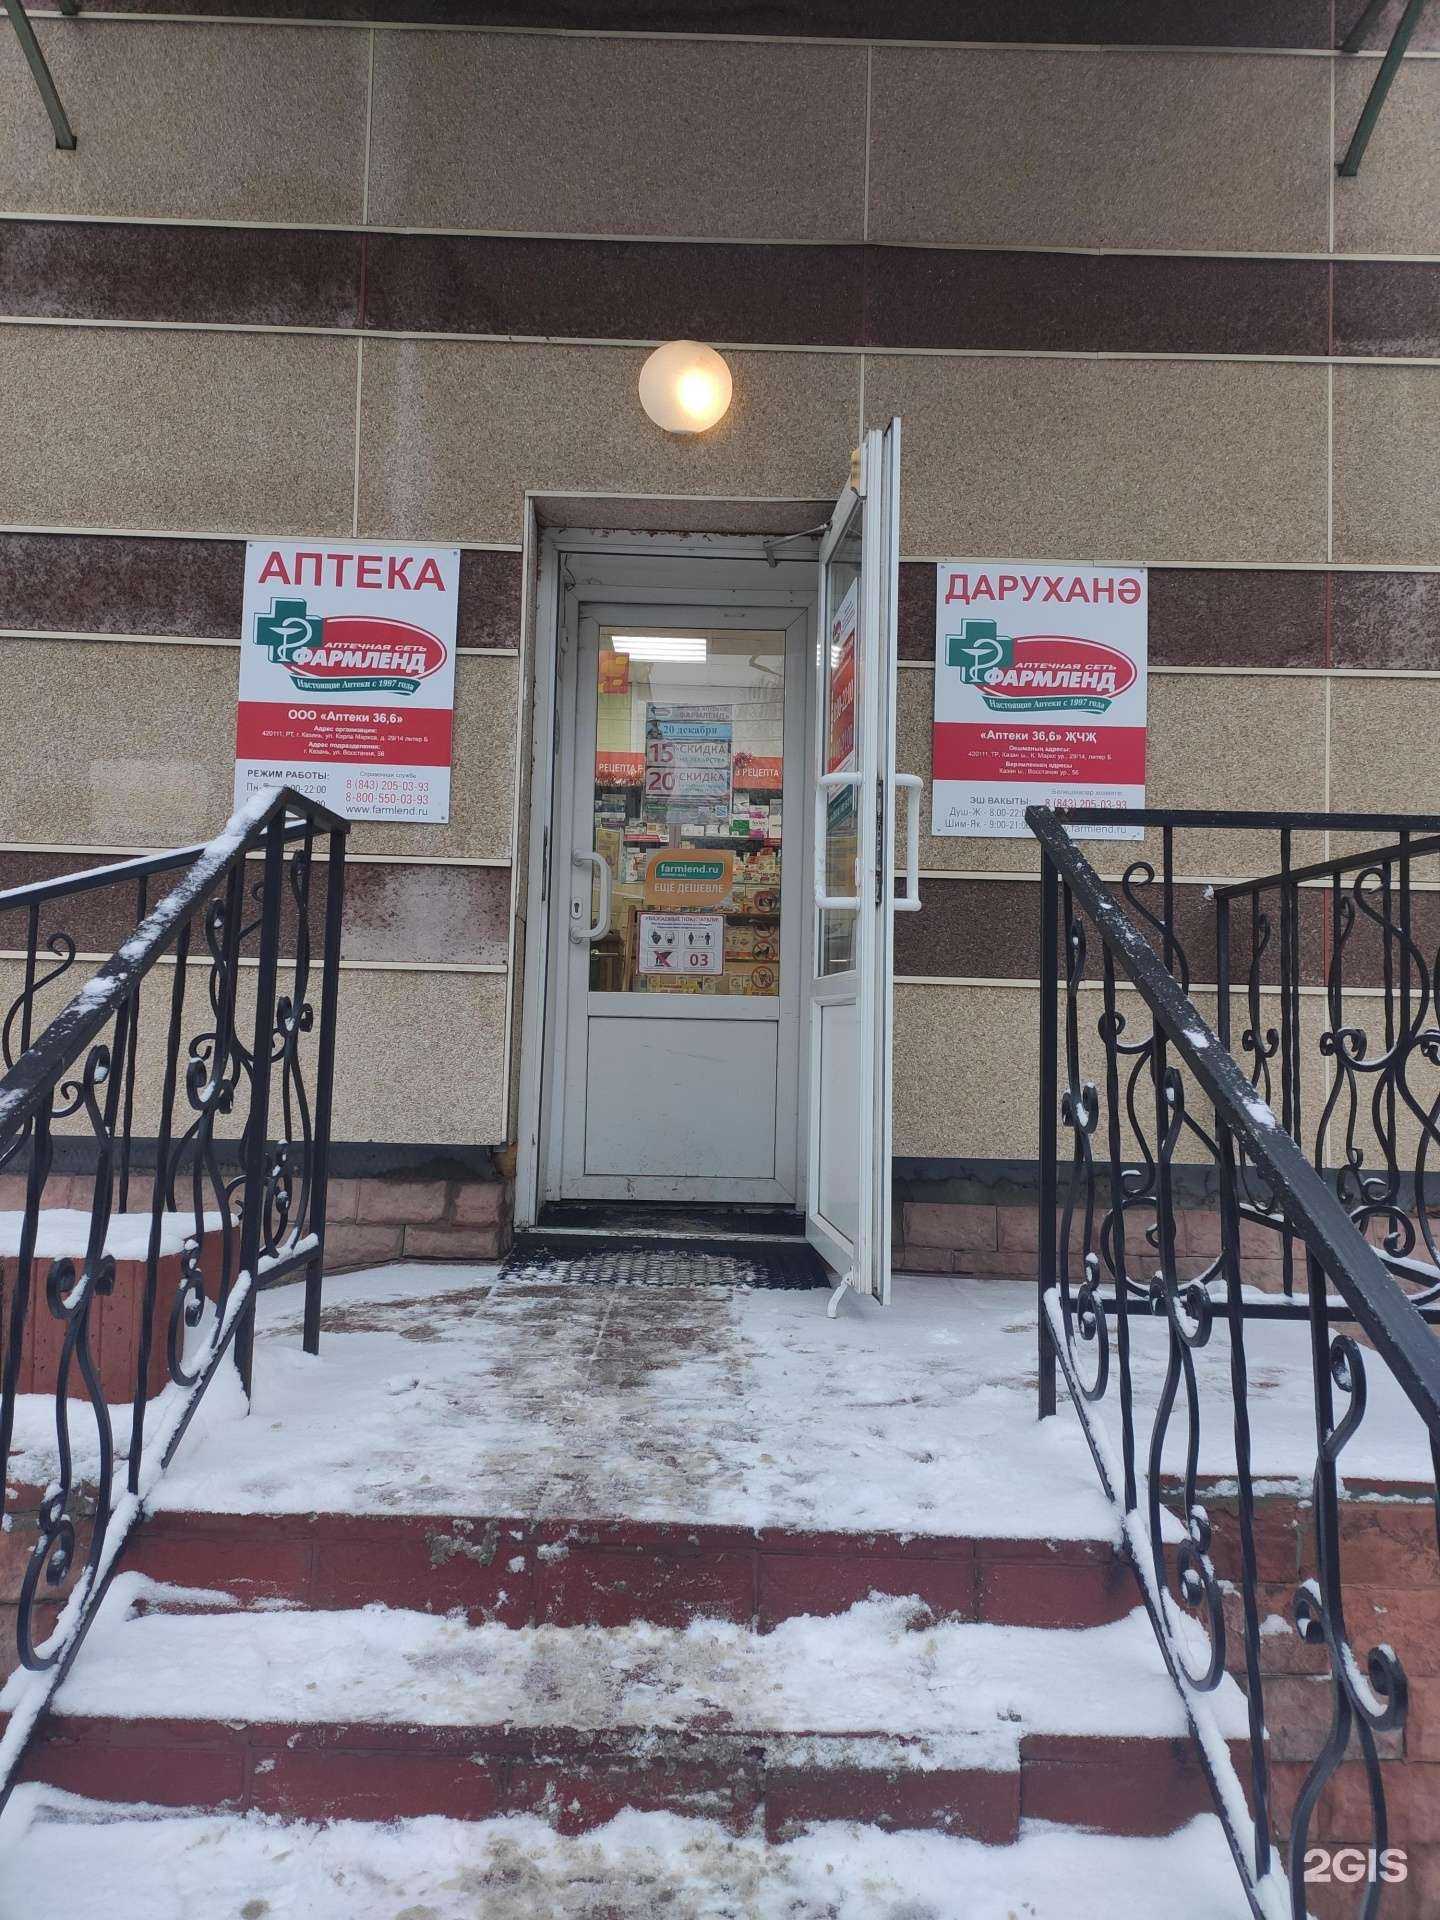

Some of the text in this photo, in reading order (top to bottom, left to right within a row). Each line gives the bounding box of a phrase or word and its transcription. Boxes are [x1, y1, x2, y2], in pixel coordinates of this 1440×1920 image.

[258, 551, 446, 592] АПТЕКА
[945, 574, 1141, 605] ДАРУХАНӘ
[324, 642, 392, 651] АПТЕЧНАЯ
[292, 647, 426, 674] ФАРМЛЕНД
[1015, 662, 1081, 670] АПТЕЧНАЯ
[296, 679, 340, 689] Настоящие
[342, 680, 370, 689] Аптеки
[398, 681, 414, 690] года
[985, 666, 1116, 692] ФАРМЛЕНД
[989, 699, 1032, 709] Настоящие
[1033, 700, 1061, 708] Аптеки
[1089, 701, 1105, 709] года
[288, 709, 403, 724] ООО «Аптеки 36,6»
[980, 730, 1028, 740] «Аптеки
[1031, 731, 1061, 742] 36,6»
[680, 744, 726, 756] СКИДКА
[248, 769, 330, 779] РЕЖИМ РАБОТЫ:
[680, 772, 725, 784] СКИДКА
[742, 769, 780, 778] РЕЦЕПТА
[346, 779, 429, 792] 8 (843) 205-03-93
[970, 796, 985, 805] ЭШ
[345, 805, 428, 816] www.farmlend.ru
[661, 863, 720, 874] farmlend.ru
[690, 953, 709, 967] 03
